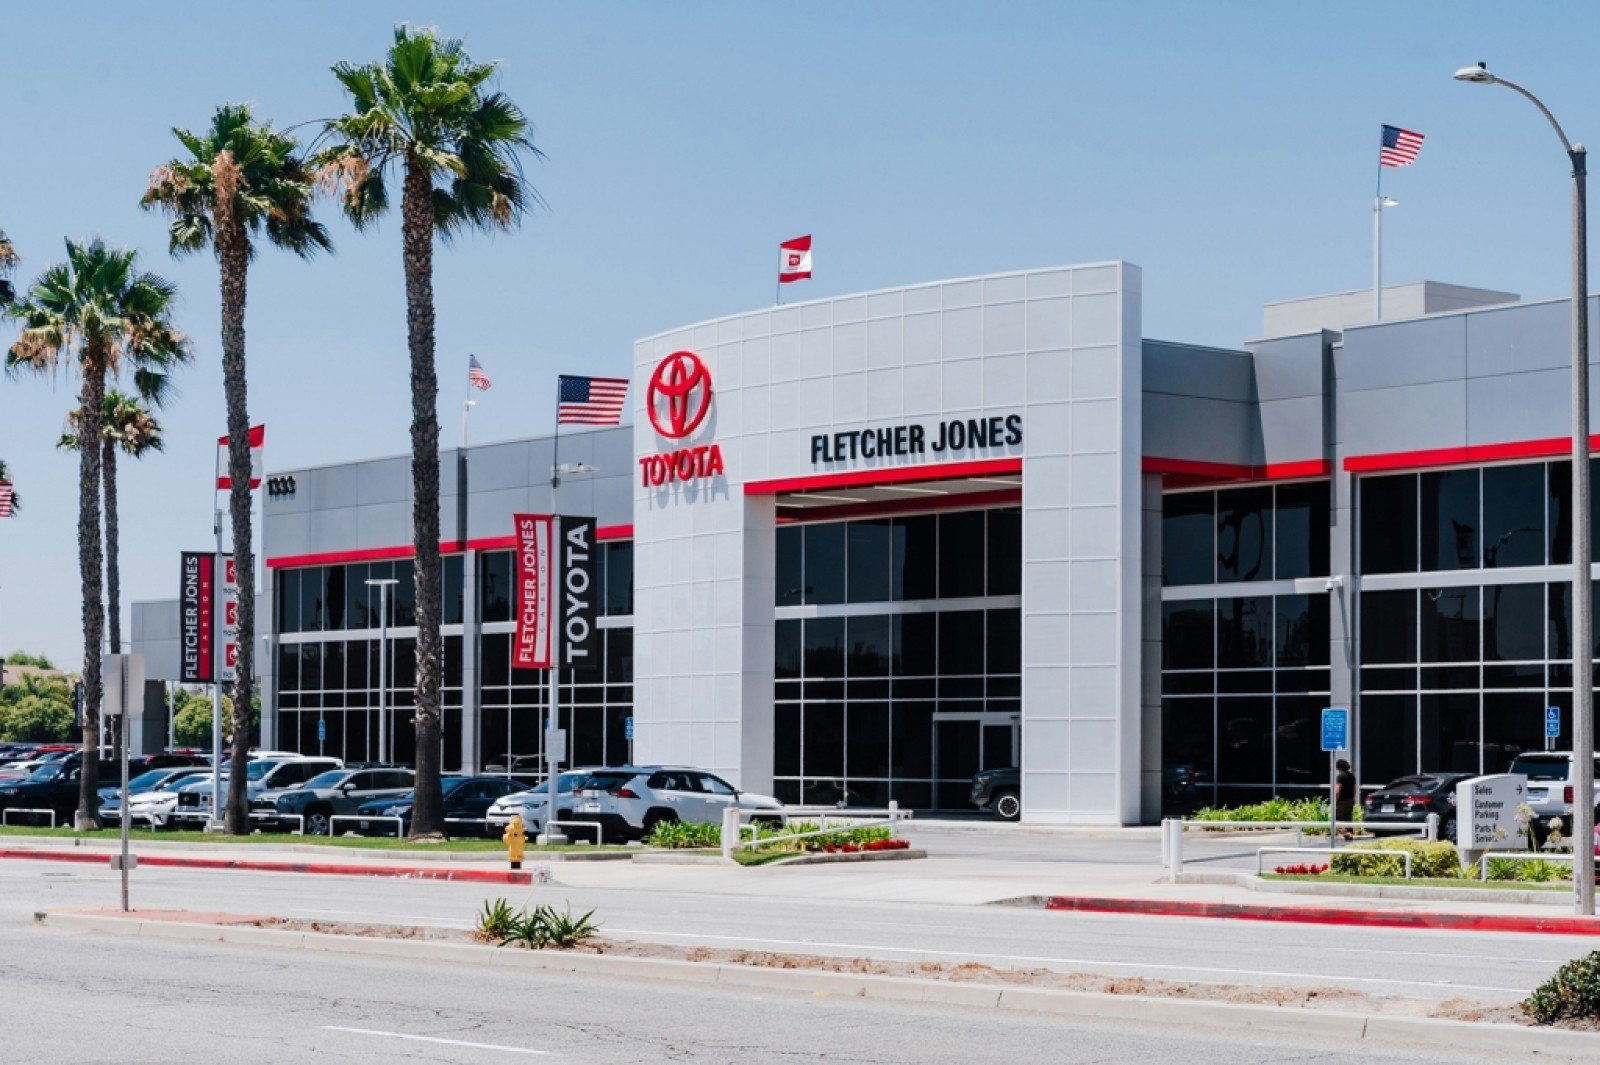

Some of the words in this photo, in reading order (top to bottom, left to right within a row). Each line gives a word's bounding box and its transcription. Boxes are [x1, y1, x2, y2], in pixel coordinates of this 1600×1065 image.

[811, 426, 925, 463] FLETCHER
[932, 414, 1022, 452] JONES
[267, 476, 296, 496] 1333
[639, 444, 724, 488] TOYOTA
[521, 519, 536, 576] JONES
[185, 556, 198, 605] JONES
[567, 523, 590, 663] TOYOTA
[185, 606, 198, 679] FLETCHER
[519, 579, 536, 663] FLETCHER
[1474, 785, 1492, 795] Sales
[1474, 800, 1503, 809] Customer
[1474, 811, 1499, 821] Parking
[1474, 824, 1491, 833] Parts
